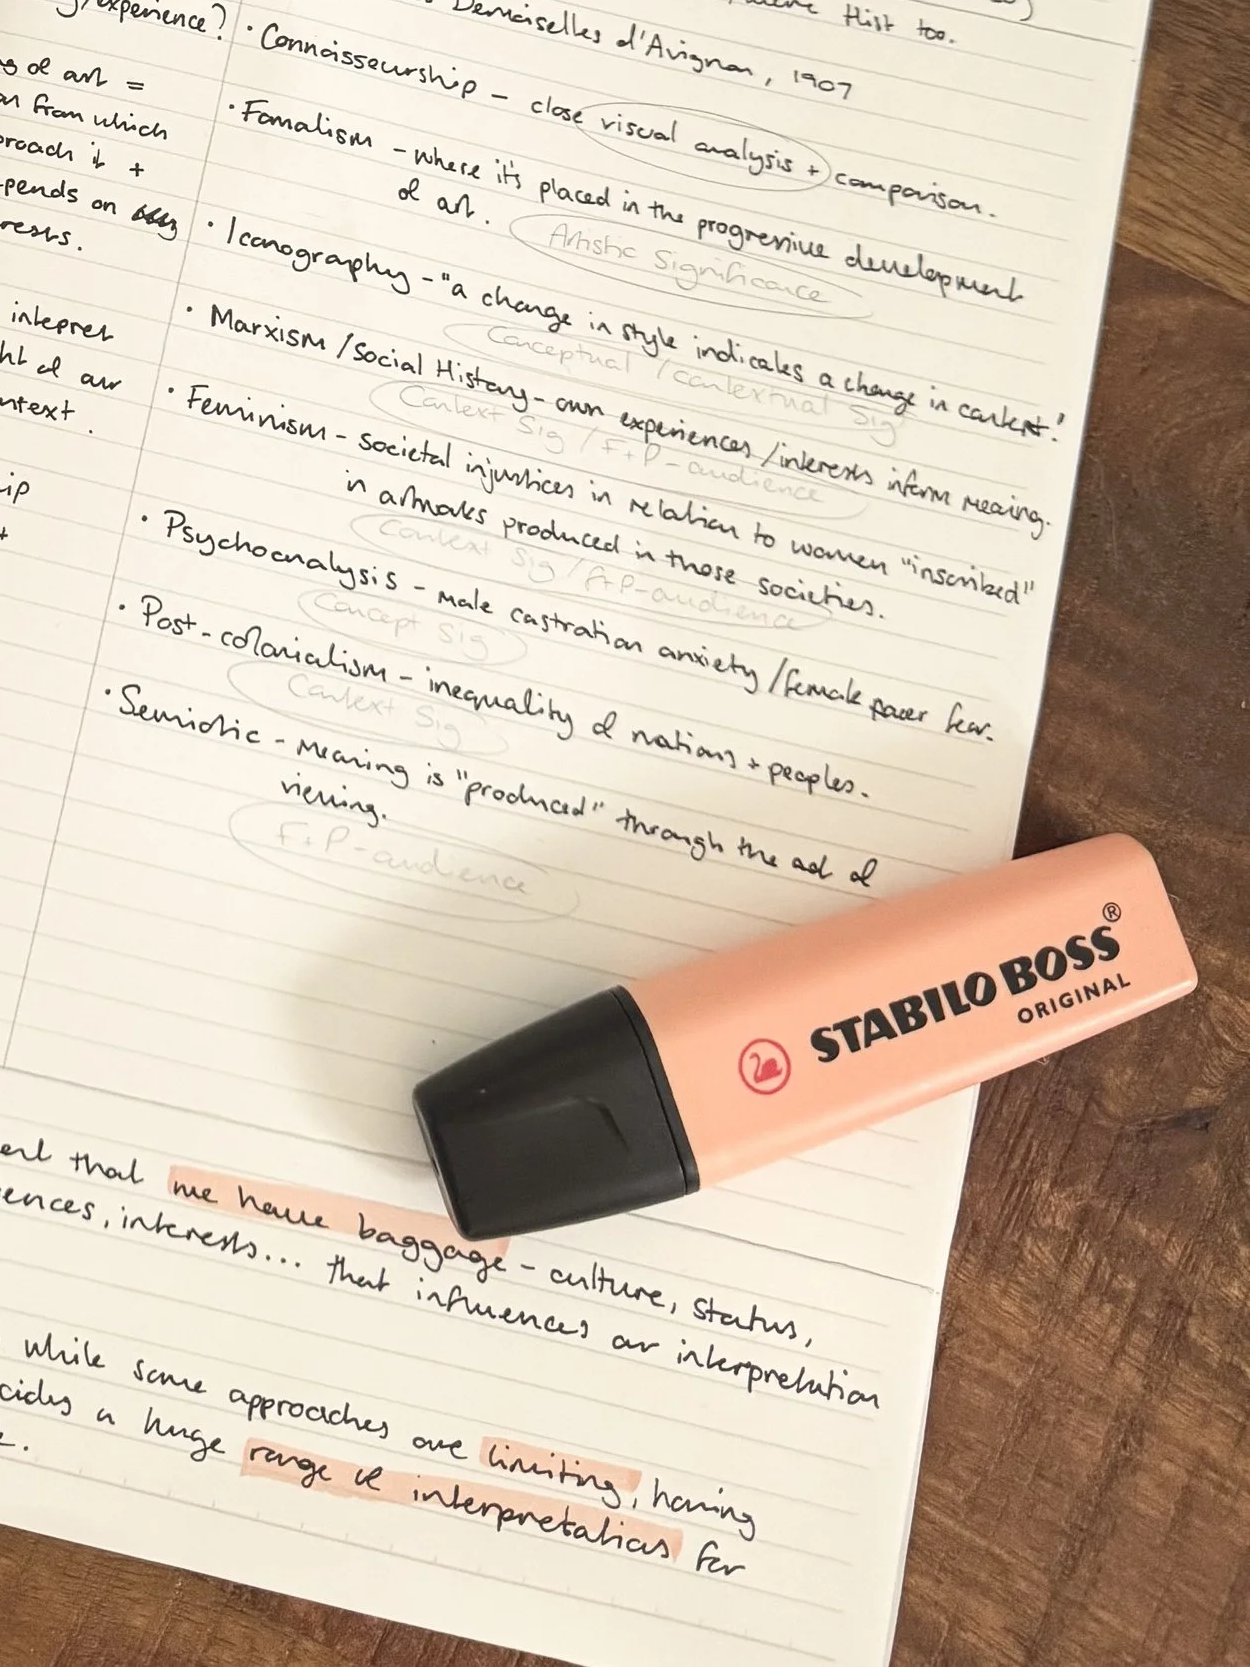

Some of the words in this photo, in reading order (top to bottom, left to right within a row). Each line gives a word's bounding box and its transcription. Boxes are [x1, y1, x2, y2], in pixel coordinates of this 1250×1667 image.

[93, 112, 168, 141] which
[530, 95, 588, 125] close
[600, 102, 678, 144] visual
[690, 136, 794, 180] analysis
[793, 69, 853, 101] 1907
[533, 177, 612, 216] placed
[839, 243, 1025, 308] development
[210, 303, 327, 351] Marxism
[619, 411, 752, 460] experiences
[481, 284, 573, 338] change
[619, 322, 679, 355] style
[696, 337, 805, 386] indicates
[186, 383, 326, 441] Feminism
[357, 432, 452, 469] societal
[465, 451, 574, 500] injustices
[628, 497, 741, 540] relation
[790, 539, 889, 576] women
[497, 516, 621, 561] produced
[163, 508, 398, 599] Psychoanalysis
[437, 587, 494, 615] male
[509, 606, 643, 654] castration
[657, 645, 760, 696] anxiety
[428, 668, 575, 742] inequality
[631, 729, 737, 770] nations
[118, 683, 261, 744] Semiotic
[614, 807, 725, 863] through
[810, 971, 998, 1064] STABILO
[998, 920, 1121, 996] BOSS
[1017, 973, 1131, 1024] ORIGINAL
[68, 1151, 145, 1186] that
[358, 1212, 513, 1285] baggage
[416, 1276, 589, 1340] influences
[24, 1332, 106, 1369] while
[228, 1388, 389, 1440] approaches
